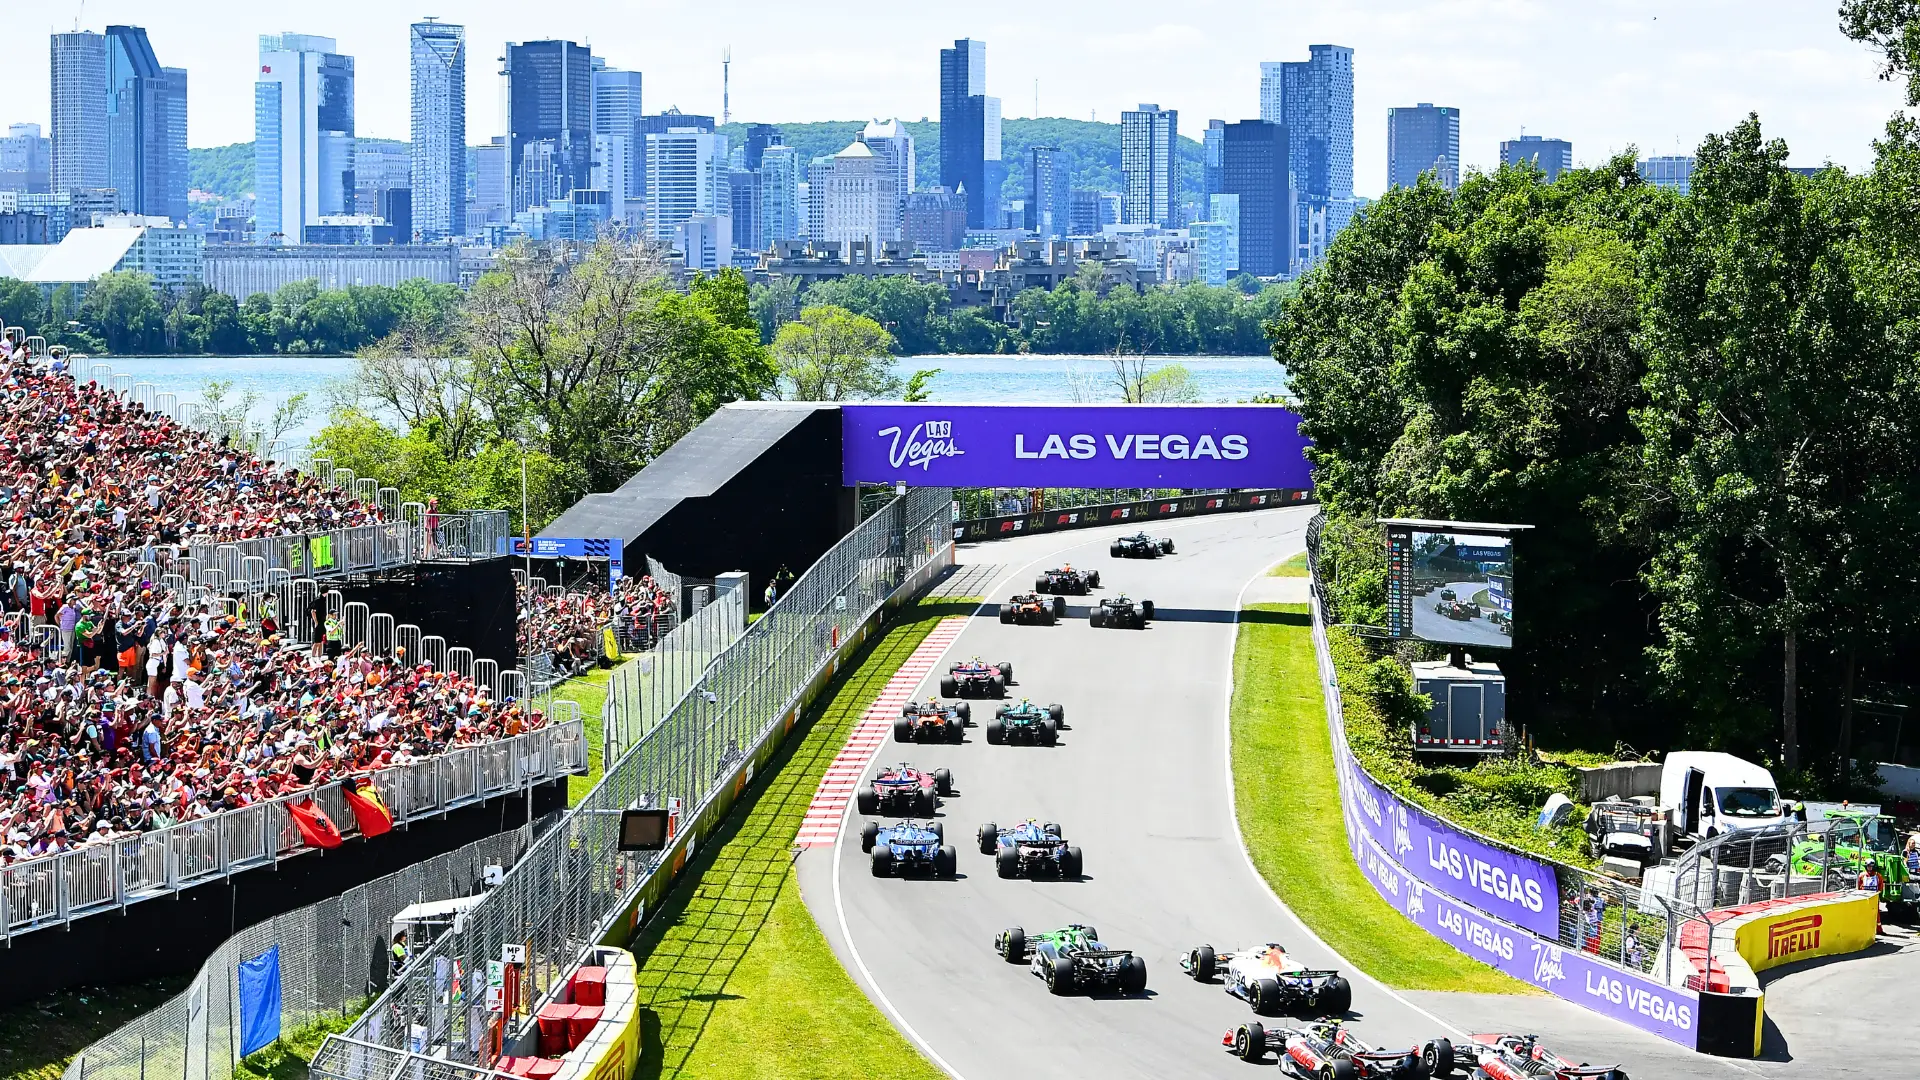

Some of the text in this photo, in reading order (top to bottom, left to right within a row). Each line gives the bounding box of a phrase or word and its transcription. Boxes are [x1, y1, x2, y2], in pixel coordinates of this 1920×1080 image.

[879, 423, 965, 471] Vegas
[927, 422, 950, 437] LAS
[1015, 434, 1249, 460] LAS VEGAS
[1427, 835, 1463, 880] LAS
[1463, 853, 1544, 913] VEGAS
[507, 946, 520, 954] MP
[1437, 903, 1462, 936] LAS
[1464, 917, 1514, 961] VEGAS
[1768, 914, 1823, 960] PIRELLI
[510, 954, 516, 962] 2
[1230, 966, 1246, 985] VISA
[1585, 969, 1692, 1030] LAS VEGAS
